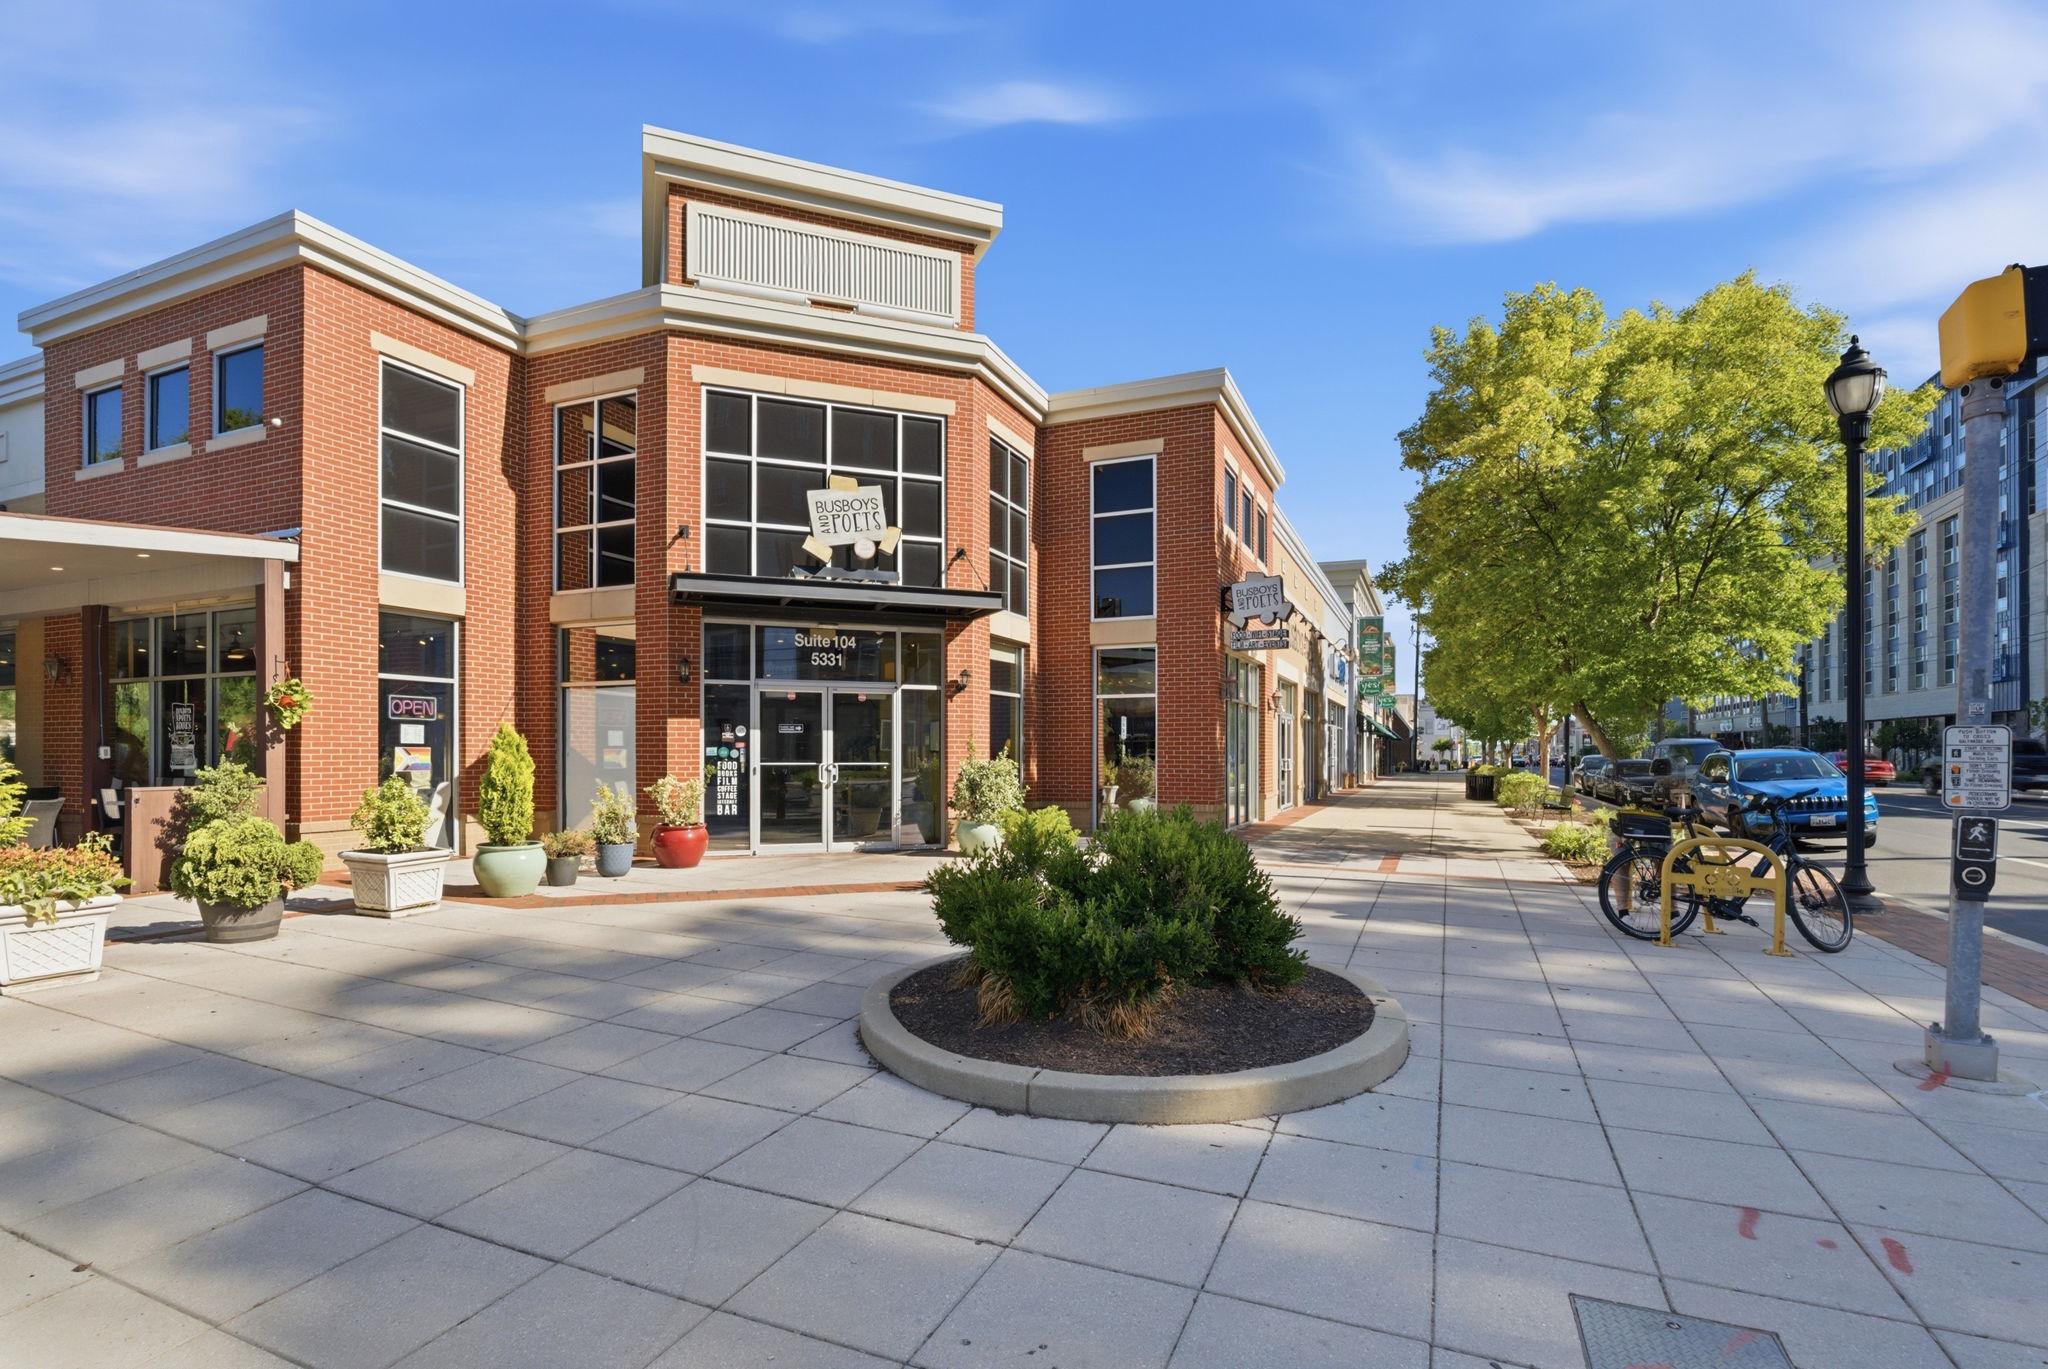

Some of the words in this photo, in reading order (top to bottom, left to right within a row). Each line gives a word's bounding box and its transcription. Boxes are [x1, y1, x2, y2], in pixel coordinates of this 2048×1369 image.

[815, 498, 879, 514] BUSBOYS
[818, 515, 831, 534] AND
[831, 511, 882, 534] POETS
[1236, 584, 1278, 598] BUSBOYS
[1246, 593, 1279, 610] POETS
[794, 633, 831, 648] Suite
[832, 635, 857, 649] 104
[811, 652, 842, 666] 5331
[392, 700, 434, 716] OPEN
[717, 761, 738, 770] FOOD
[717, 777, 738, 785] FILM
[717, 804, 738, 815] BAR
